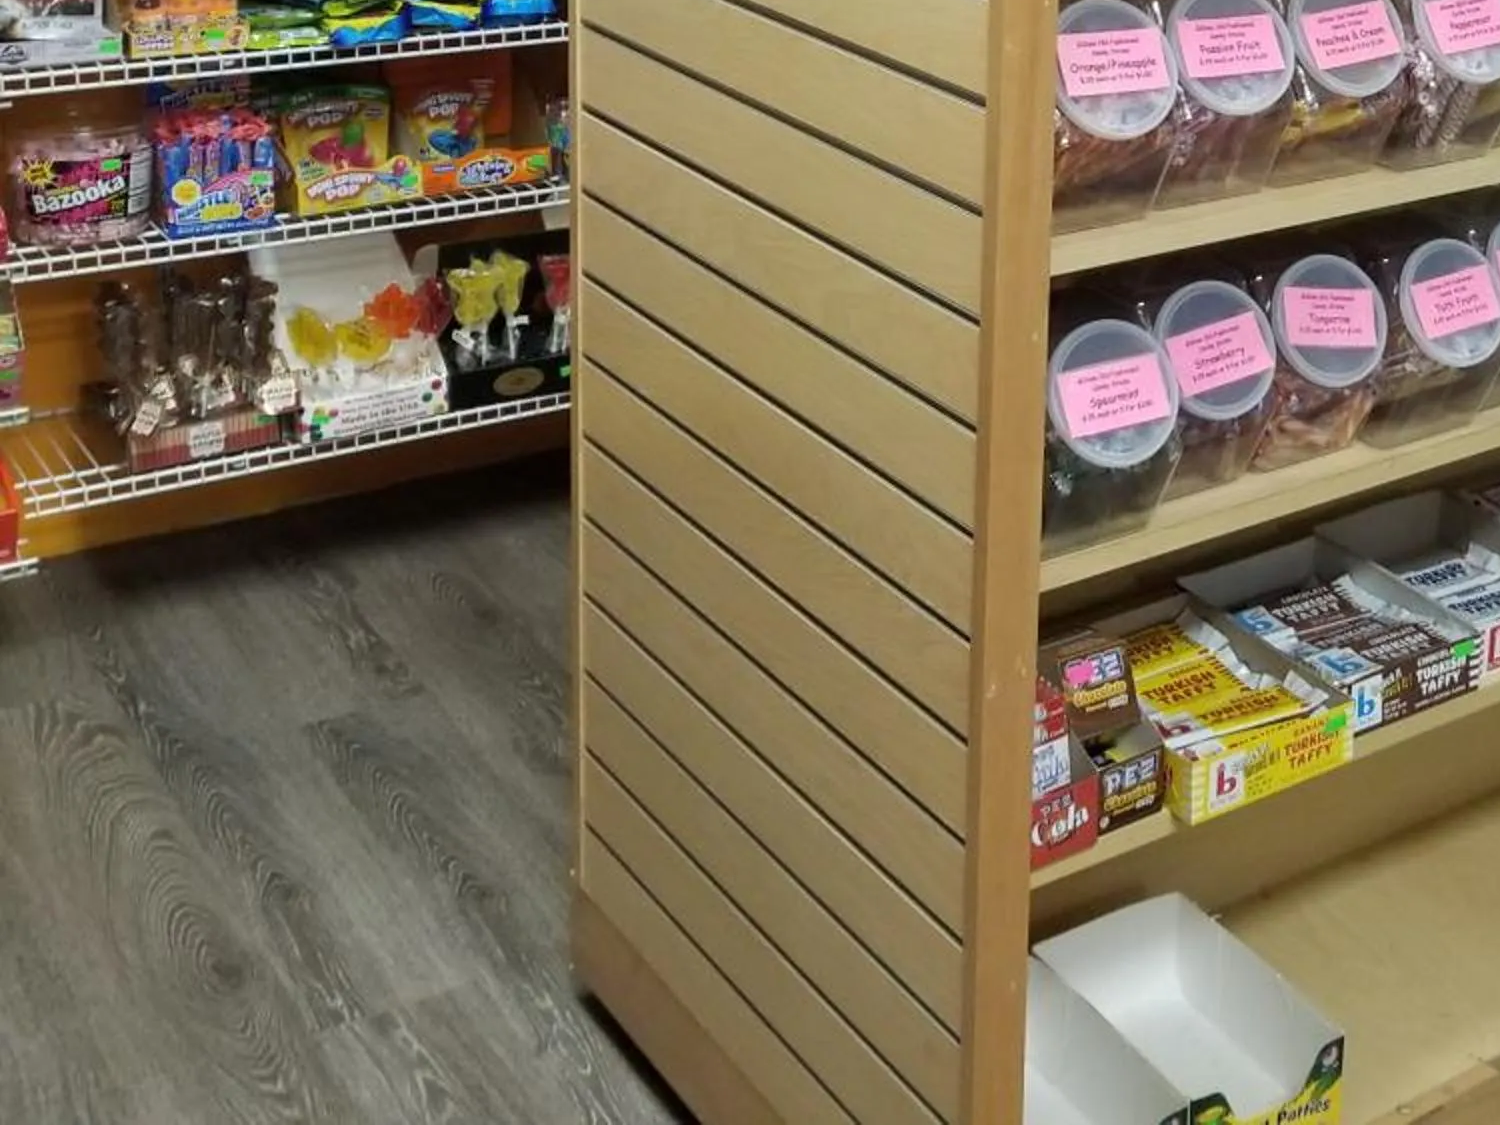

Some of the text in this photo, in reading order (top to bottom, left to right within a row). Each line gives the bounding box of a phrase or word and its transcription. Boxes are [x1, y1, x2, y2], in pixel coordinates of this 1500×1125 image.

[1200, 40, 1261, 55] Passion Fruit
[32, 176, 125, 215] Bazooka
[1310, 312, 1351, 325] Tangerine
[1194, 346, 1246, 370] Strawberry
[1089, 389, 1139, 410] Spearmint
[1404, 561, 1464, 586] TURKISH
[1273, 593, 1340, 618] TURKISH
[1287, 603, 1342, 623] TAFFY
[1417, 656, 1467, 683] TURKISH
[1421, 669, 1462, 696] TAFFY
[1143, 671, 1217, 700] TURKISH
[1160, 681, 1217, 706] TAFFY
[1200, 694, 1280, 724] TURKISH
[1357, 688, 1376, 718] b
[1289, 742, 1334, 770] TAFFY
[1216, 762, 1237, 798] b
[1031, 807, 1089, 847] Cola
